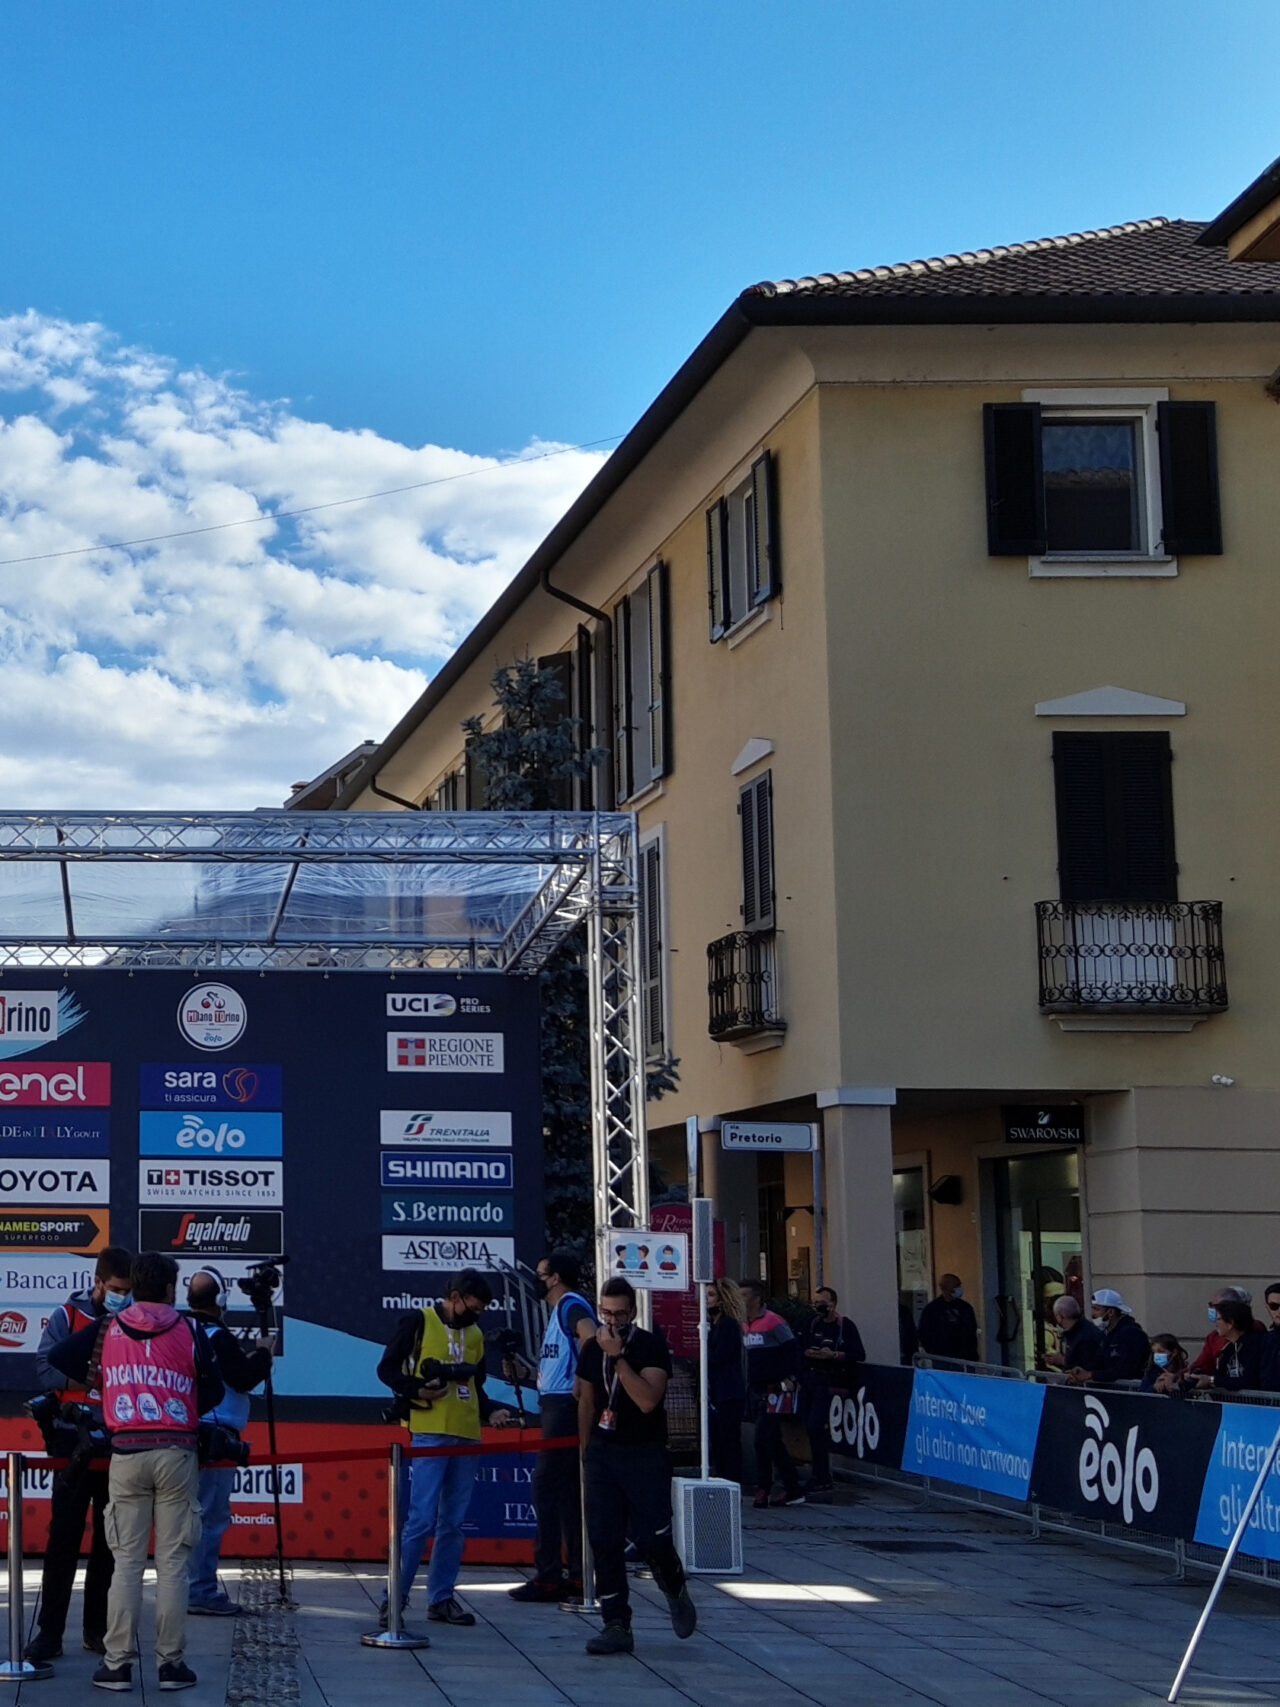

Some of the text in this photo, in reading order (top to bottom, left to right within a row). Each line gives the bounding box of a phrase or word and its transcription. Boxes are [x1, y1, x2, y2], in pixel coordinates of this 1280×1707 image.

[391, 998, 429, 1012] UCI
[460, 1005, 491, 1013] SERIES
[428, 1039, 494, 1053] REGIONE
[428, 1054, 494, 1067] PIEMONTE
[164, 1071, 216, 1088] sara
[165, 1093, 216, 1103] ti assicura
[176, 1120, 246, 1153] eolo
[430, 1128, 490, 1137] TRENITALIA
[730, 1132, 782, 1143] Pretorio
[1009, 1127, 1080, 1139] SWAROVSKI
[183, 1170, 275, 1186] TISSOT
[388, 1161, 505, 1179] SHIMANO
[179, 1189, 221, 1197] WATCHES
[392, 1201, 504, 1222] S.Bernardo
[171, 1213, 251, 1246] Segafredo
[403, 1240, 493, 1261] ASTORIA
[6, 1270, 92, 1290] Banca Ifi
[913, 1388, 958, 1422] Internet
[829, 1386, 880, 1458] eolo
[915, 1427, 1030, 1480] gli altri non arrivano
[1079, 1422, 1159, 1524] eolo
